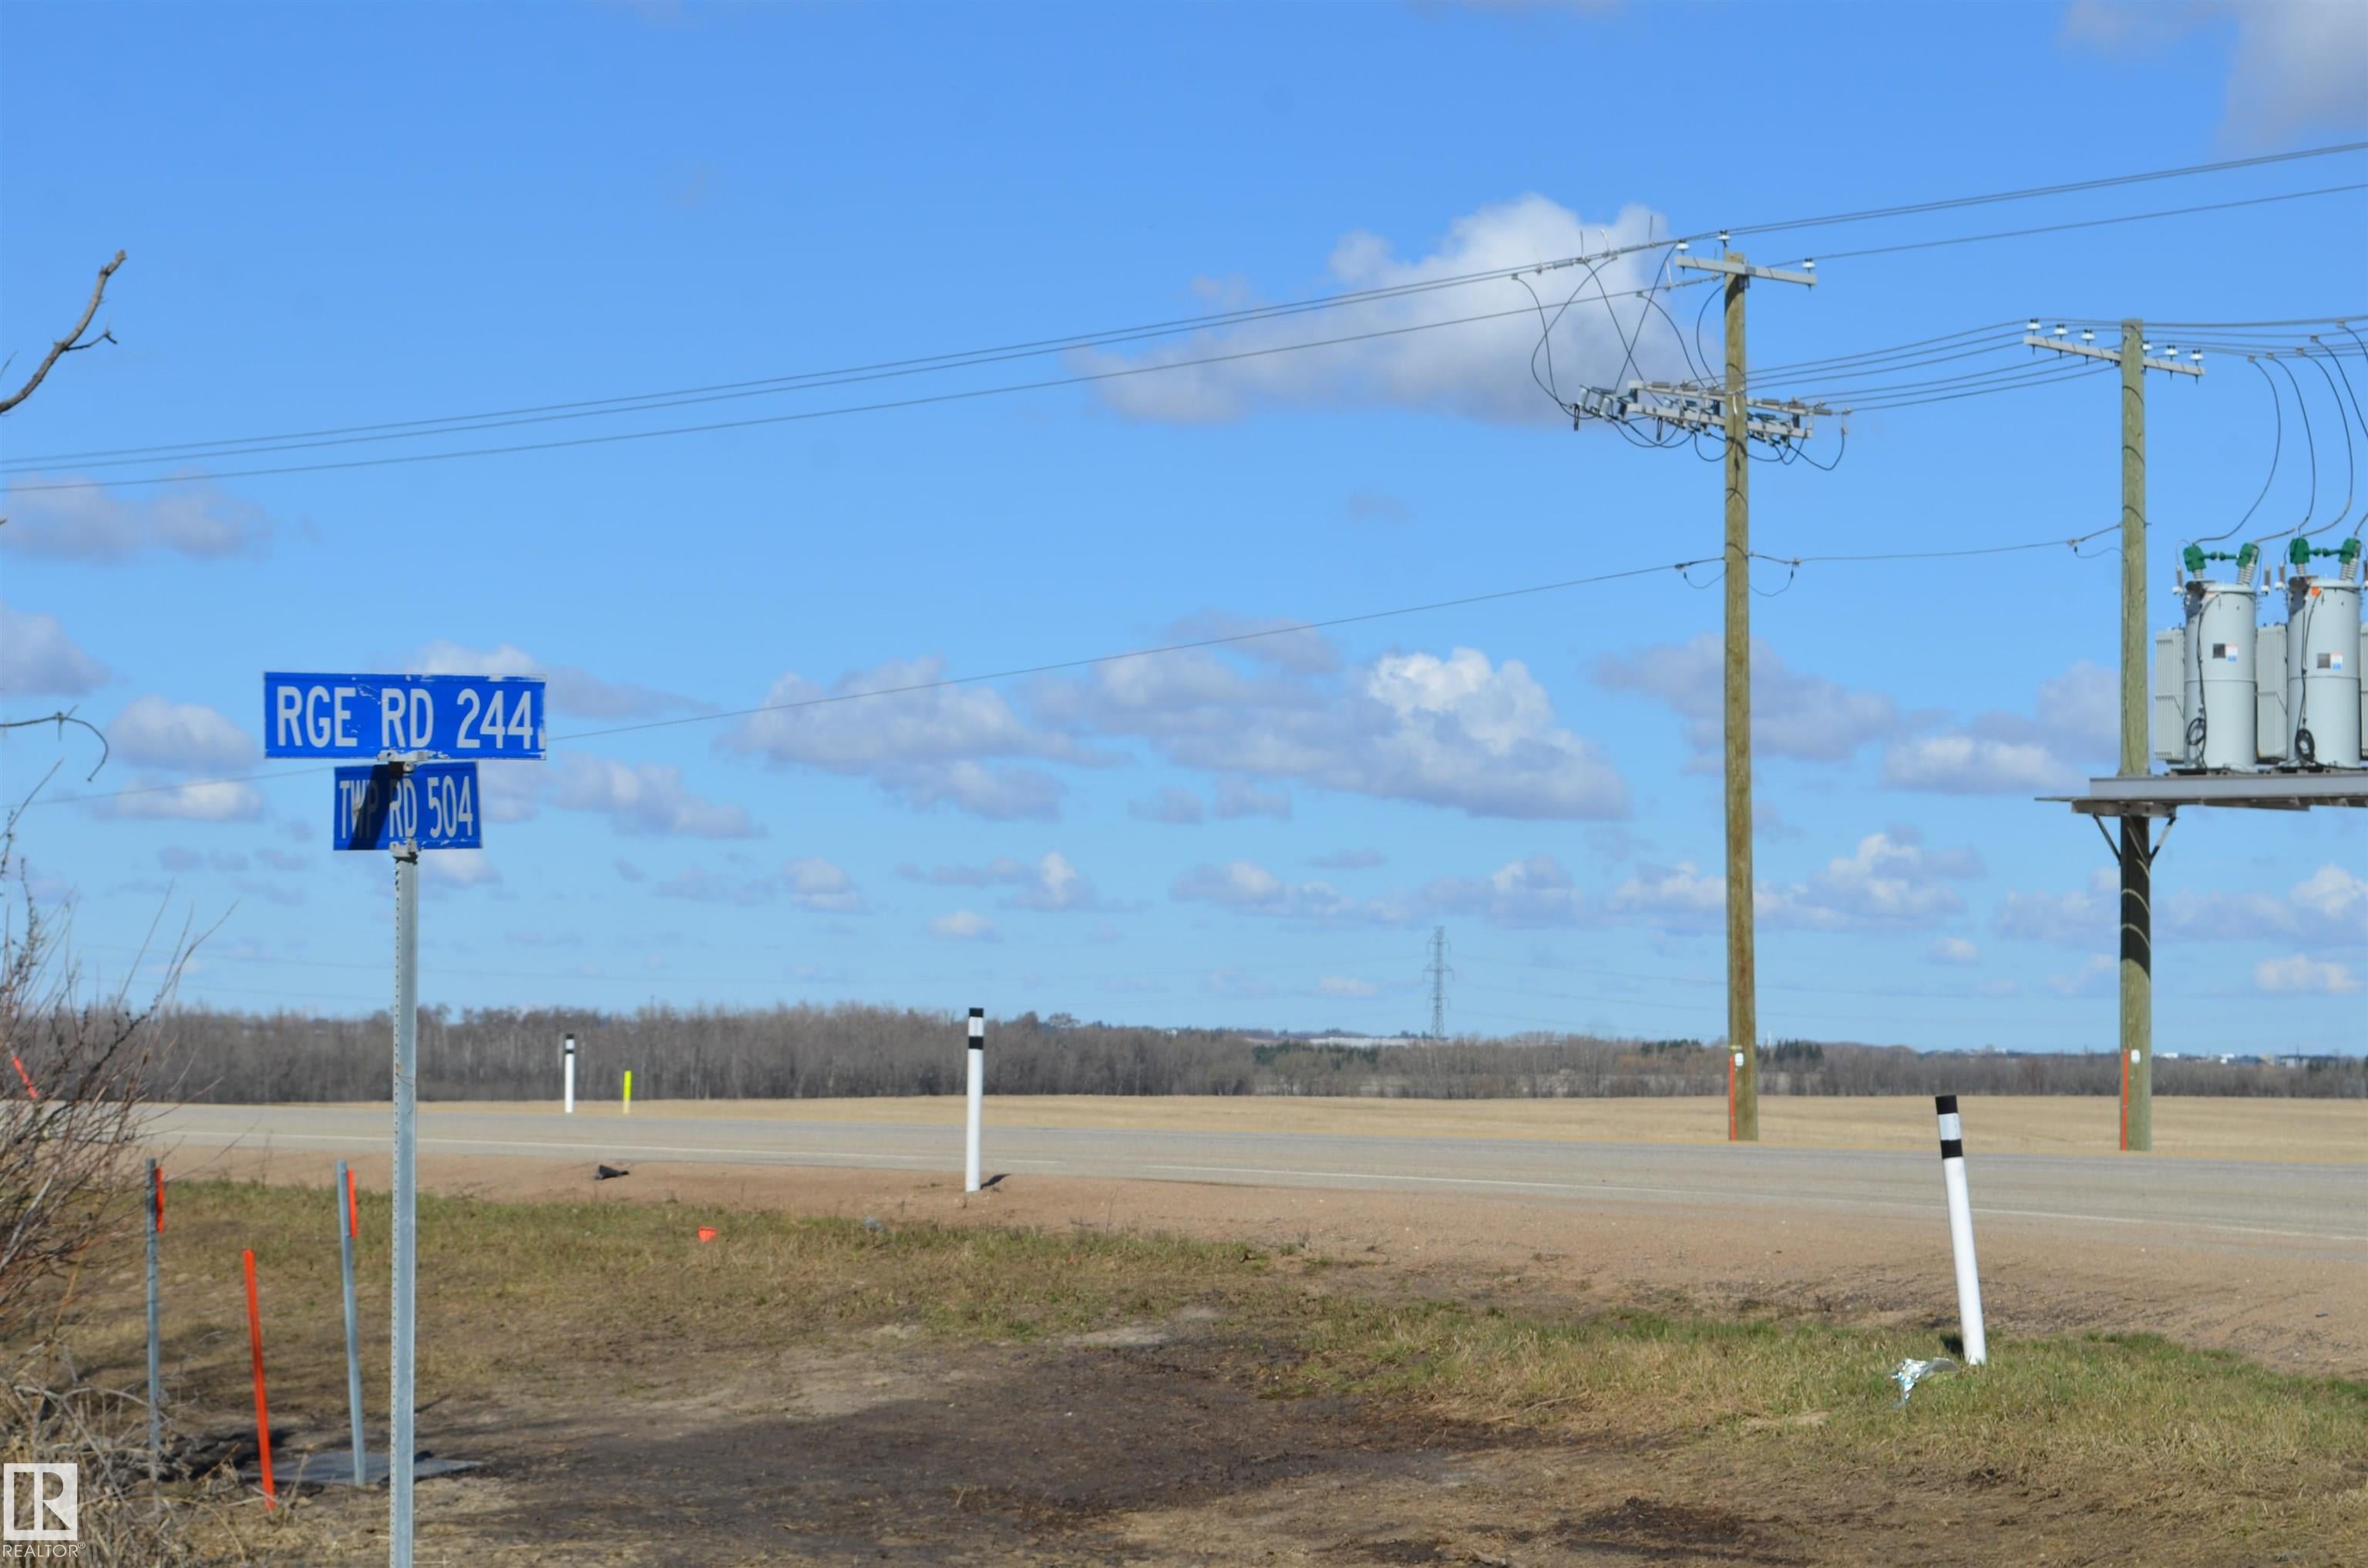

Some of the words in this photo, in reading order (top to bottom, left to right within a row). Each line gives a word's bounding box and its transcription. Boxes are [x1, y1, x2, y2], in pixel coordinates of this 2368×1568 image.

[277, 685, 358, 748] RGE
[382, 688, 434, 748] RD
[456, 689, 533, 749] 244
[389, 777, 418, 838] RD
[427, 775, 473, 838] 504
